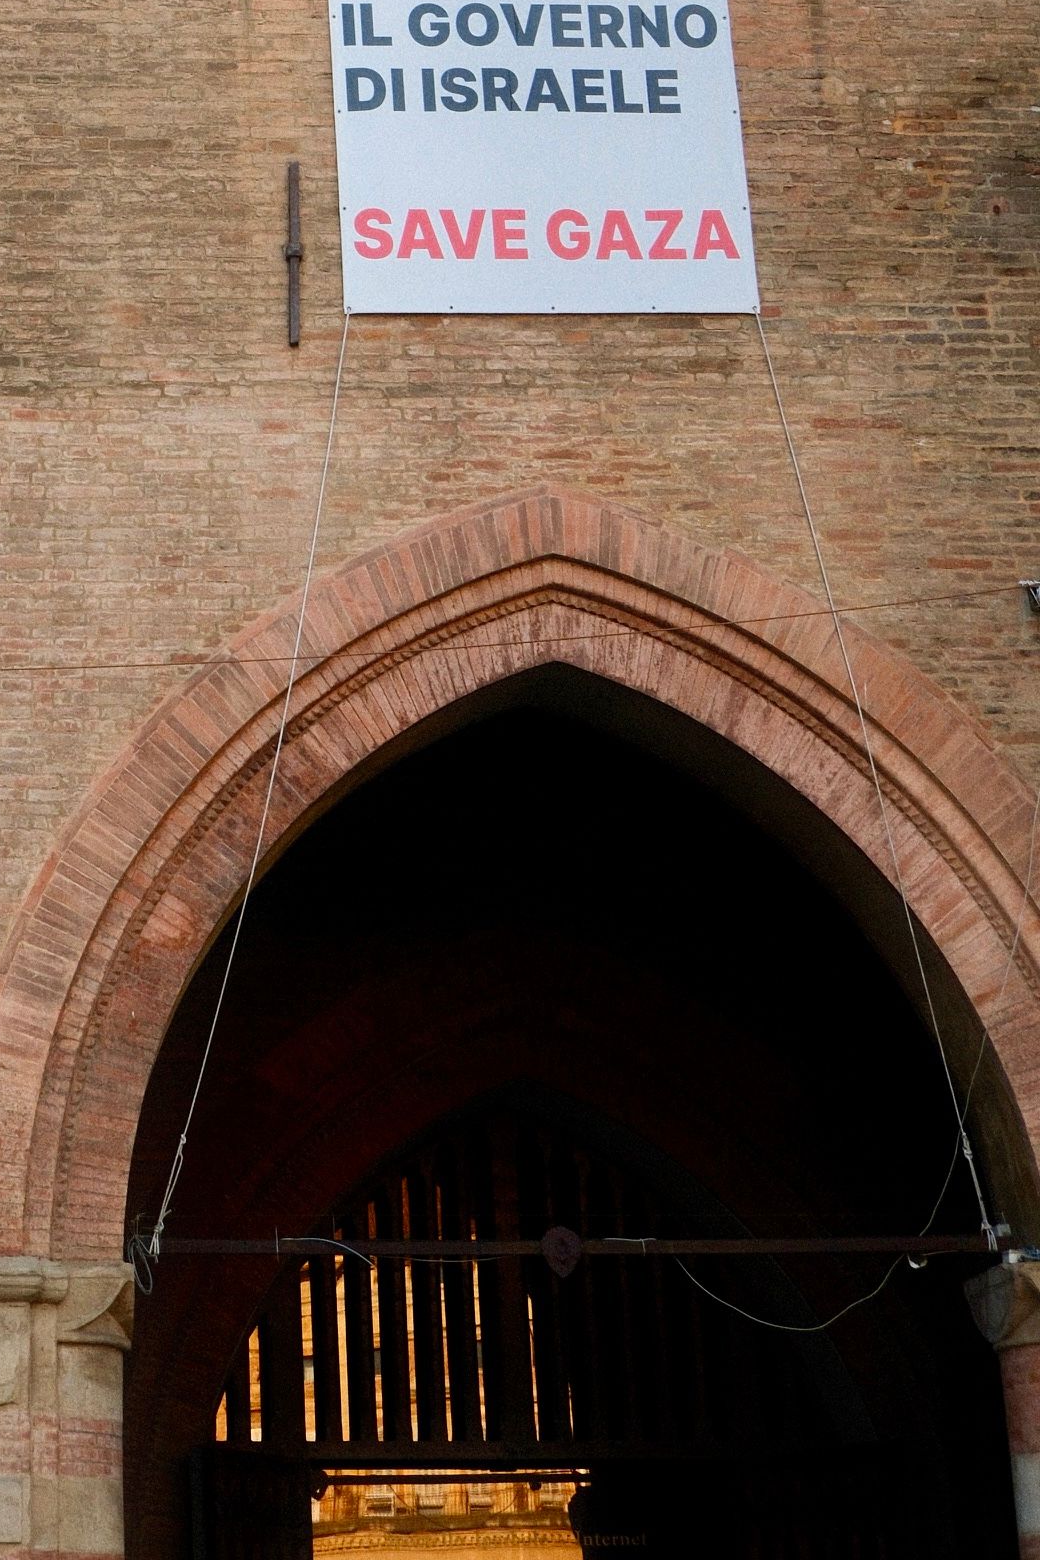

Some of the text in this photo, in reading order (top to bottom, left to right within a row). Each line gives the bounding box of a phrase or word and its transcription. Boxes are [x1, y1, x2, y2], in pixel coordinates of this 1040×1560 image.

[341, 2, 718, 48] IL GOVERNO
[344, 67, 682, 114] DI ISRAELE
[353, 207, 741, 260] SAVE GAZA
